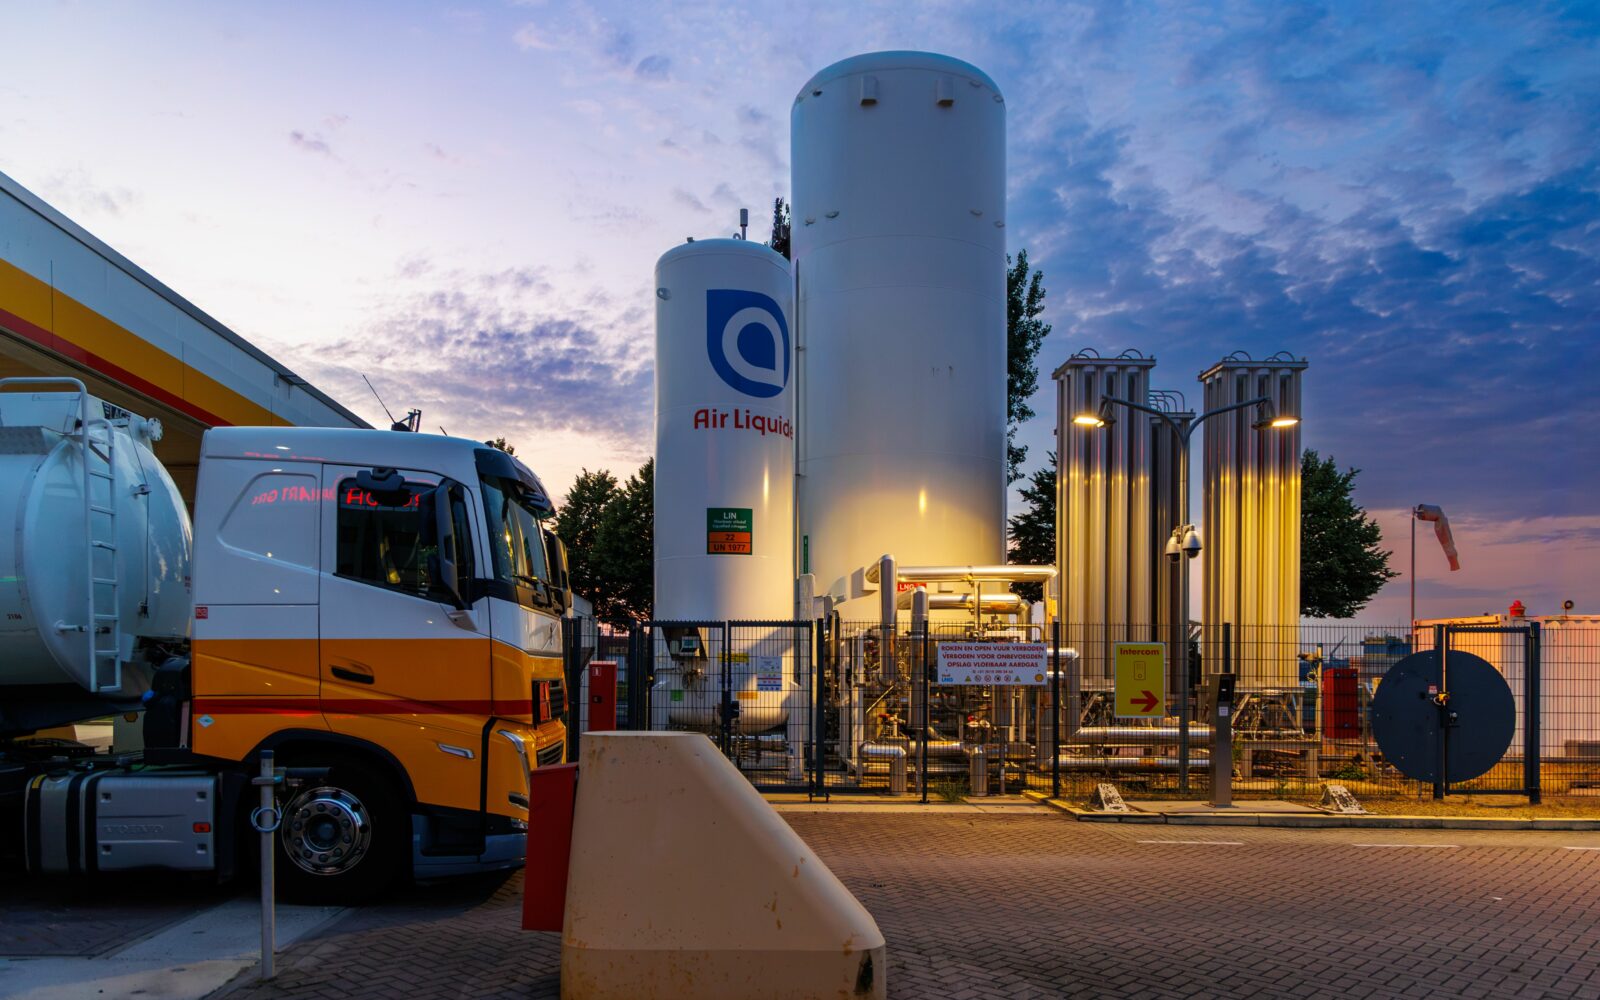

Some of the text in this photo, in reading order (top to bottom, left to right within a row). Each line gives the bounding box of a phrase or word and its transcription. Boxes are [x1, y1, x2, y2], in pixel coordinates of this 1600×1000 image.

[694, 408, 729, 429] Air
[723, 511, 737, 520] LIN
[725, 533, 736, 541] 22
[713, 543, 746, 551] UN 1977
[1120, 647, 1160, 656] Intercom
